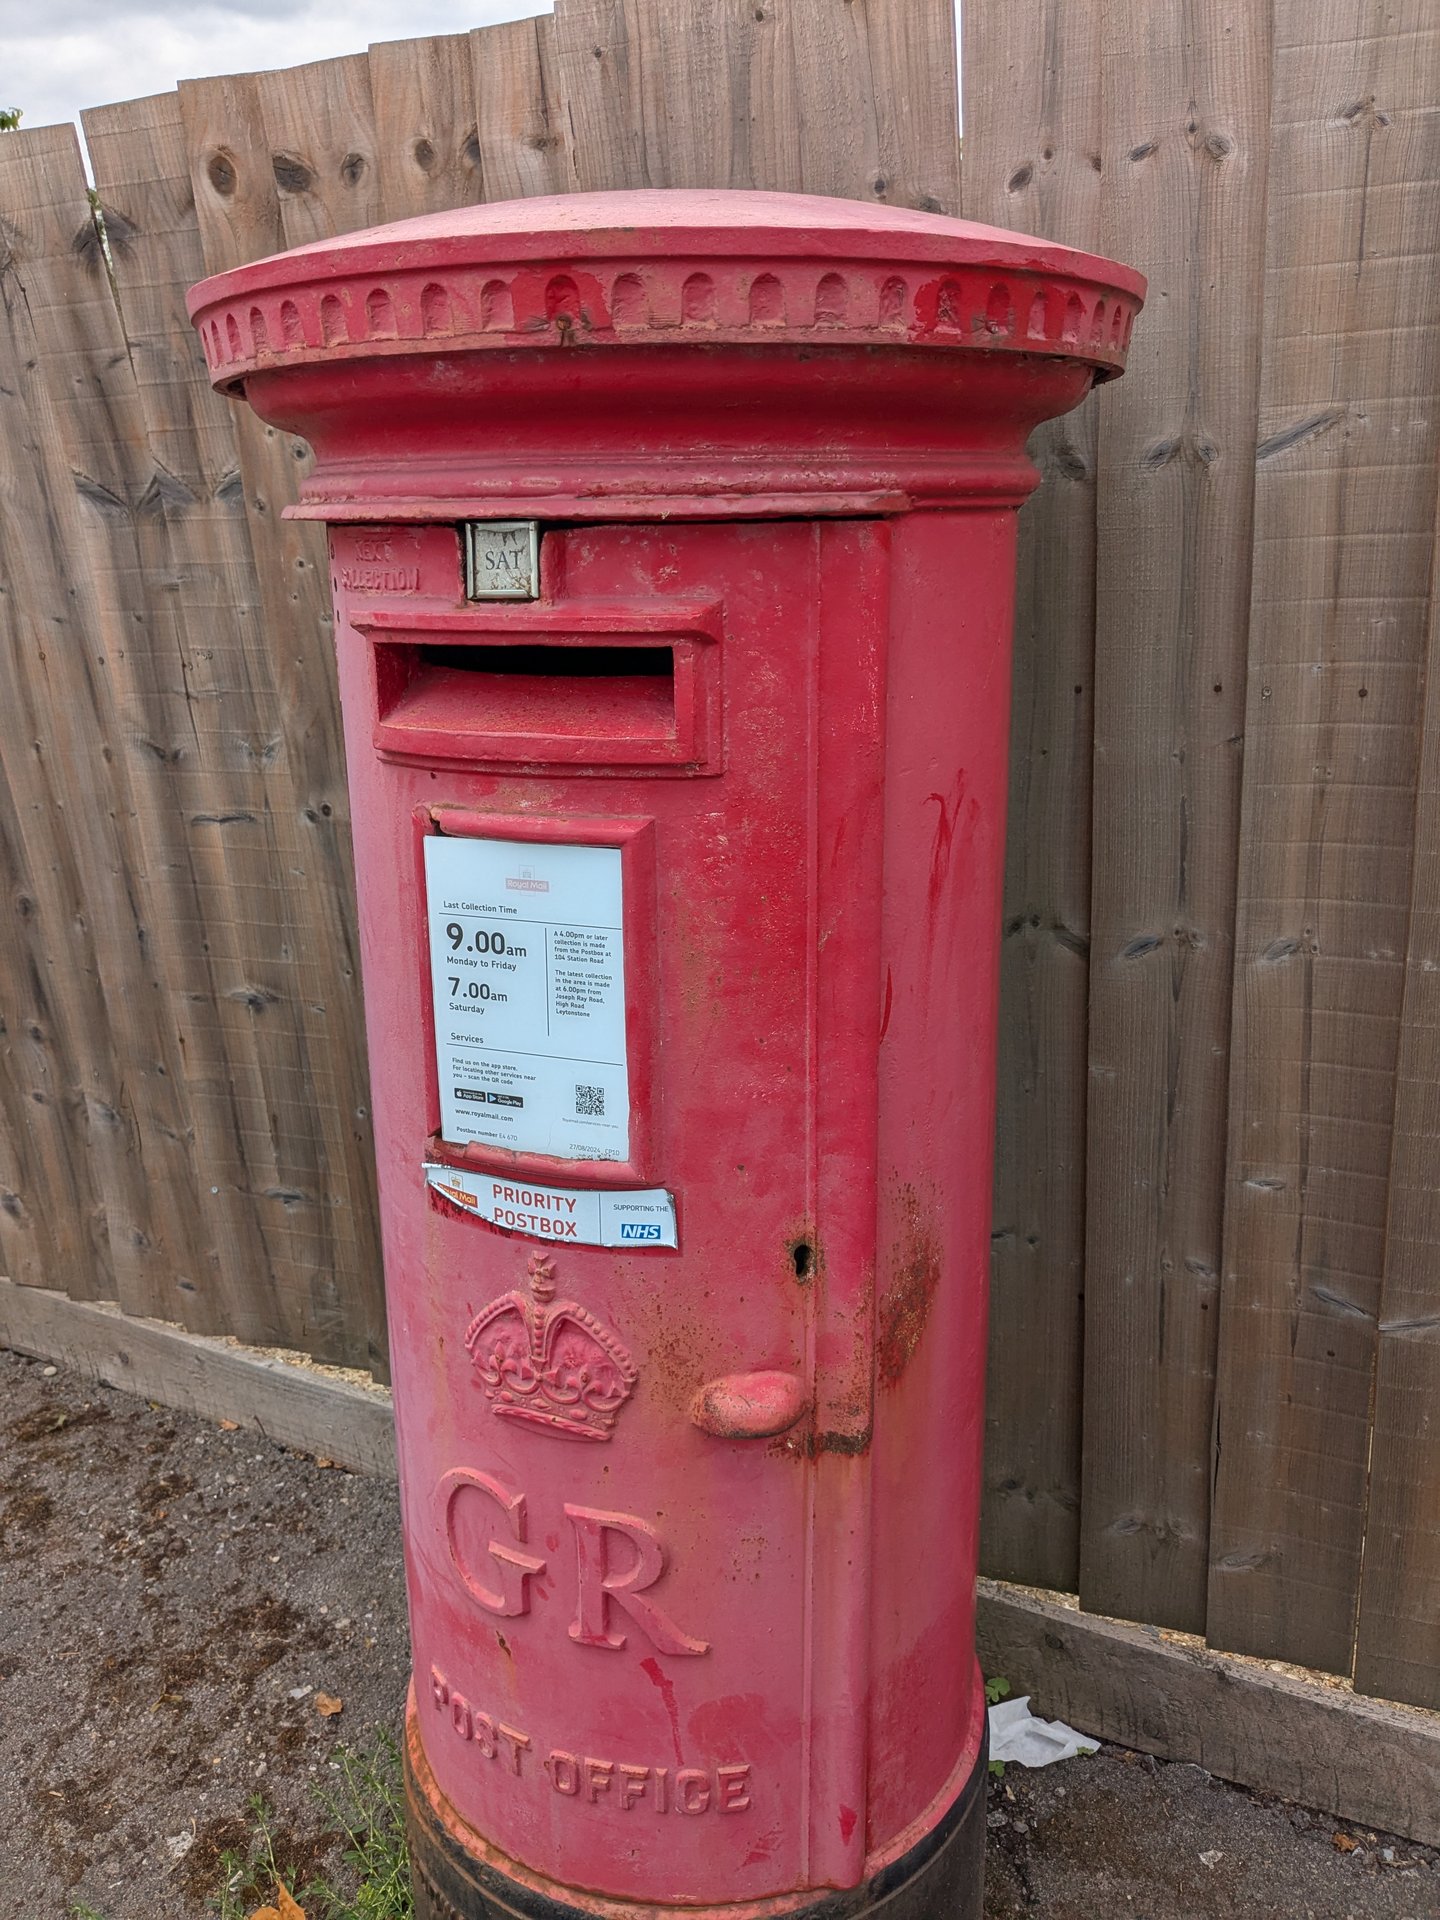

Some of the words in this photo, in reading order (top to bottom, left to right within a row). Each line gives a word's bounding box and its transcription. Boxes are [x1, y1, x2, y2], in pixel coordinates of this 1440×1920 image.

[484, 550, 523, 570] SAT
[507, 880, 529, 890] Royal
[530, 881, 547, 890] Mail
[443, 900, 460, 909] Last
[461, 902, 497, 912] Collection
[498, 905, 518, 914] Time
[446, 922, 527, 957] 9.00am
[559, 930, 585, 939] 4.00pm
[554, 939, 582, 947] collection
[580, 948, 604, 956] Postbox
[446, 955, 478, 968] Monday
[480, 960, 489, 968] to
[491, 960, 517, 972] Friday
[567, 970, 584, 978] latest
[585, 972, 613, 980] collection
[447, 976, 508, 1002] 7.00am
[562, 986, 586, 994] 6.00pm
[555, 993, 575, 1001] Joseph
[576, 995, 587, 1003] Ray
[449, 1002, 485, 1015] Saturday
[555, 1000, 569, 1008] High
[570, 1001, 585, 1009] Road
[555, 1008, 590, 1017] Leytonstone
[450, 1032, 484, 1044] Services
[462, 1066, 484, 1075] locating
[500, 1071, 523, 1079] services
[497, 1097, 512, 1105] Google
[512, 1099, 522, 1107] Play
[455, 1108, 514, 1122] www.royalmail.com
[456, 1126, 477, 1135] Postbox
[477, 1130, 498, 1138] number
[459, 1192, 476, 1205] Mail
[492, 1183, 577, 1213] PRIORITY
[613, 1203, 655, 1212] SUPPORTING
[493, 1207, 578, 1237] POSTBOX
[622, 1225, 660, 1238] NHS
[431, 1663, 532, 1777] POST
[548, 1749, 752, 1815] OFFICE
